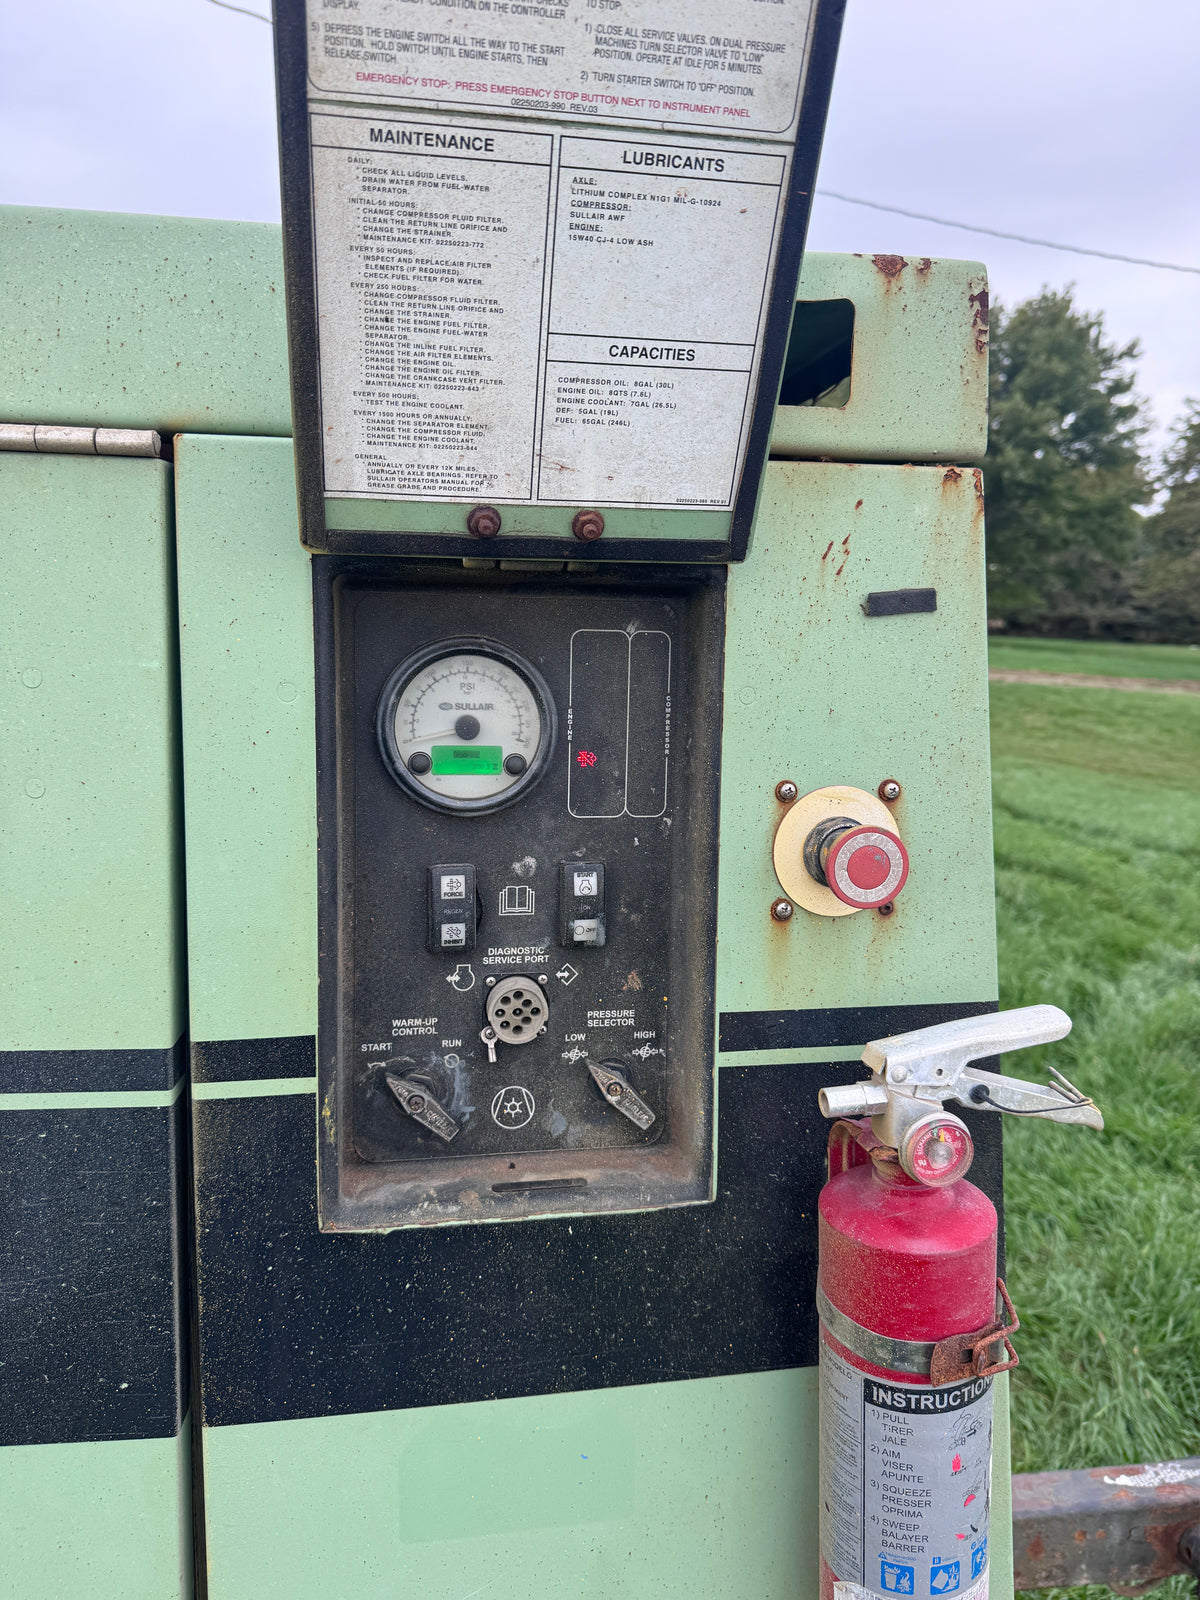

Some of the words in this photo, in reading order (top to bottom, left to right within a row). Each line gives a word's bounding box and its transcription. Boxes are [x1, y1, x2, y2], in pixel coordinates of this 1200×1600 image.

[312, 22, 320, 32] 5)
[325, 24, 363, 36] DEPRESS
[366, 28, 381, 38] THE
[384, 29, 415, 40] ENGINE
[417, 32, 450, 44] SWITCH
[453, 36, 467, 47] ALL
[470, 38, 486, 48] THE
[488, 39, 506, 49] WAY
[509, 41, 519, 50] TO
[522, 42, 537, 53] THE
[540, 44, 564, 56] START
[584, 23, 592, 34] 1)
[597, 24, 622, 35] CLOSE
[625, 27, 639, 37] ALL
[642, 29, 674, 42] SERVICE
[710, 36, 721, 46] ON
[724, 38, 743, 49] DUAL
[746, 40, 785, 53] PRESSURE
[580, 71, 588, 81] 2)
[593, 72, 614, 82] TURN
[617, 74, 651, 87] STARTER
[654, 78, 684, 90] SWITCH
[687, 81, 696, 91] TO
[356, 72, 418, 87] EMERGENCY
[456, 81, 487, 93] PRESS
[491, 84, 551, 98] EMERGENCY
[554, 90, 579, 100] STOP
[582, 93, 618, 104] BUTTON
[621, 97, 645, 108] NEXT
[648, 100, 660, 109] TO
[663, 101, 720, 115] INSTRUMENT
[723, 107, 750, 118] PANEL
[511, 98, 565, 111] 02250203-990
[570, 103, 597, 113] REV.03
[370, 128, 494, 152] MAINTENANCE
[623, 150, 724, 172] LUBRICANTS
[389, 178, 414, 186] WATER
[418, 180, 438, 188] FROM
[441, 182, 489, 192] FUEL-WATER
[572, 177, 597, 185] AXLE:
[572, 188, 605, 197] LITHIUM
[608, 190, 647, 200] COMPLEX
[674, 196, 721, 207] MIL-G-10924
[571, 200, 631, 211] COMPRESSOR:
[363, 207, 394, 216] CHANGE
[397, 210, 449, 220] COMPRESSOR
[570, 211, 605, 220] SULLAIR
[570, 223, 603, 232] ENGINE:
[569, 234, 594, 242] 15W40
[596, 236, 614, 244] CJ-4
[609, 345, 695, 361] CAPACITIES
[558, 377, 611, 385] COMPRESSOR
[558, 387, 586, 395] ENGINE
[367, 418, 395, 426] CHANGE
[460, 682, 475, 690] PSI
[488, 947, 544, 955] DIAGNOSTIC
[483, 956, 523, 964] SERVICE
[525, 955, 549, 963] PORT
[588, 1010, 635, 1018] PRESSURE
[392, 1018, 438, 1027] WARM-UP
[588, 1018, 635, 1027] SELECTOR
[392, 1027, 438, 1036] CONTROL
[362, 1043, 392, 1051] START
[883, 1413, 909, 1425] PULL
[882, 1435, 907, 1447] JALE
[870, 1445, 879, 1455] 2)
[882, 1449, 901, 1459] AIM
[882, 1459, 914, 1472] VISER
[881, 1469, 924, 1483] APUNTE
[871, 1480, 879, 1490] 3)
[883, 1484, 932, 1497] SQUEEZE
[882, 1495, 932, 1508] PRESSER
[882, 1505, 923, 1518] OPRIMA
[870, 1515, 879, 1526] 4)
[882, 1518, 920, 1531] SWEEP
[882, 1529, 928, 1543] BALAYER
[881, 1539, 925, 1553] BARRER
